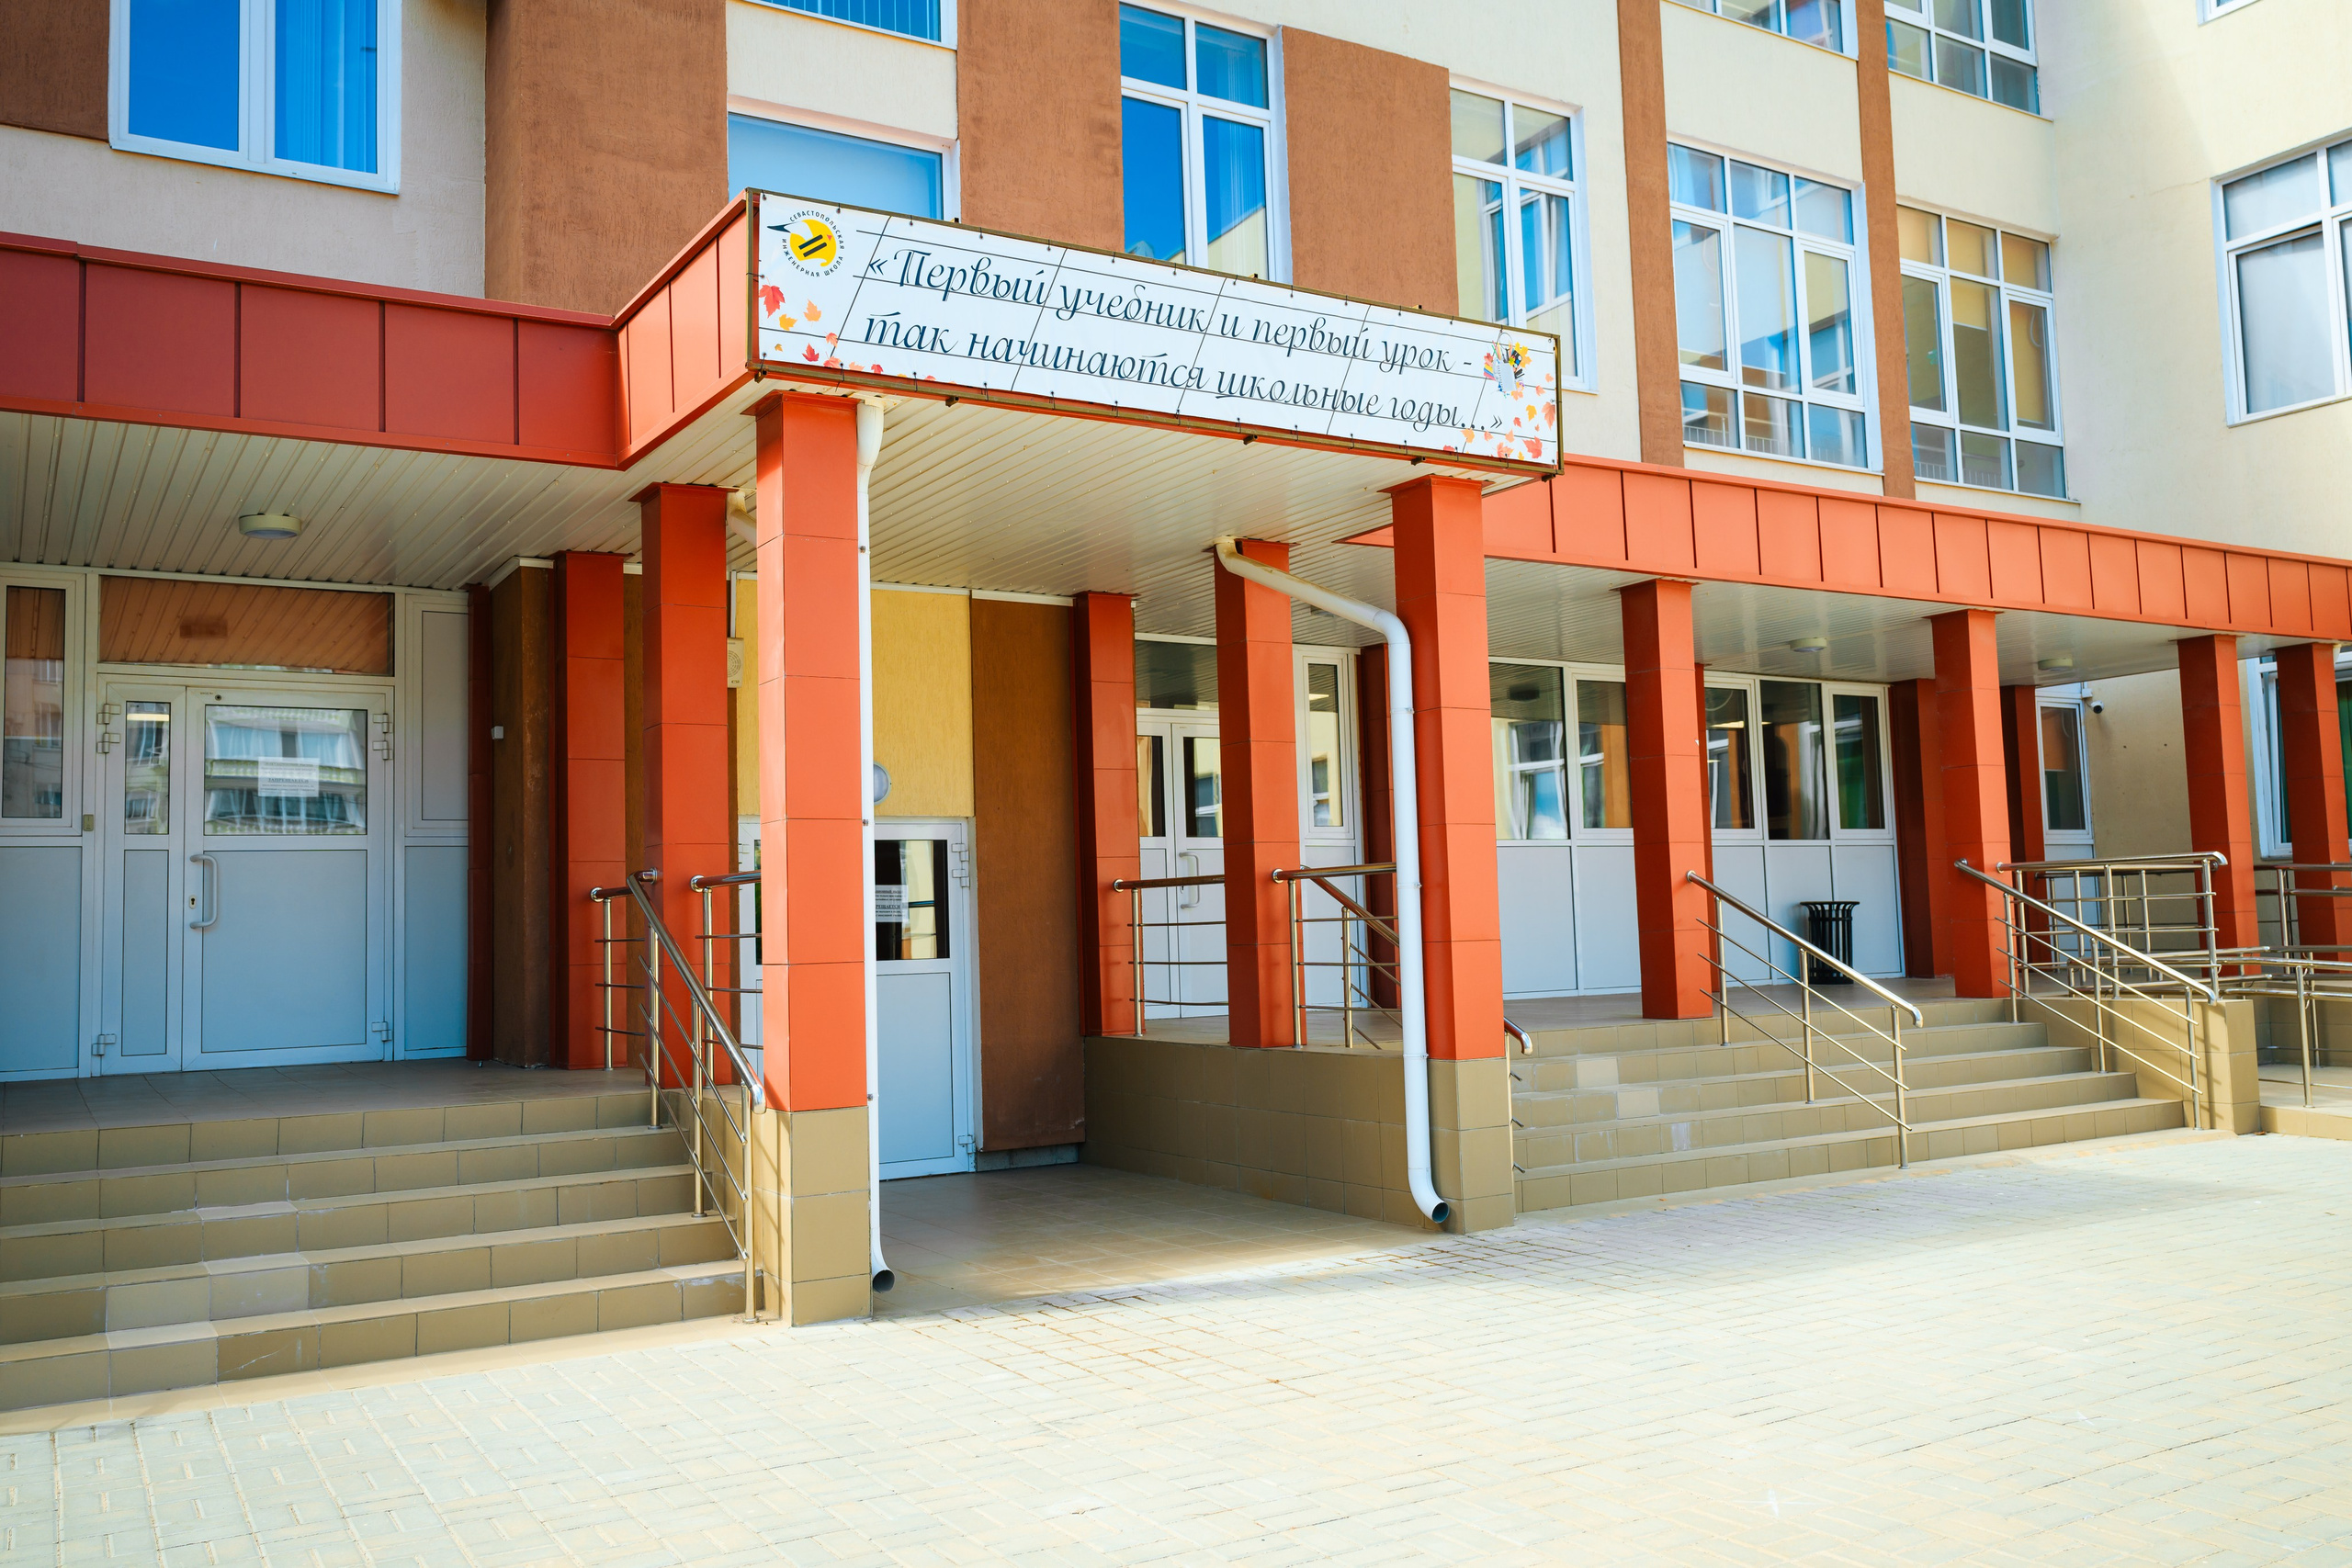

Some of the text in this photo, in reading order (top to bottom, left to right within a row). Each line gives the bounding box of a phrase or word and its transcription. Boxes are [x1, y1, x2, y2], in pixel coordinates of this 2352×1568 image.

[782, 238, 843, 277] ИНЖЕНЕРНАЯ ШКОЛА
[789, 210, 845, 250] СЕВАСТОПОЛЬСКАЯ
[868, 248, 1054, 305] «Первый
[1057, 284, 1211, 333] учебник
[1220, 312, 1246, 338] и
[1252, 316, 1375, 358] первый
[1378, 338, 1455, 376] урок
[865, 311, 958, 353] так
[967, 332, 1210, 390] начинаются
[1216, 368, 1384, 415] школьные
